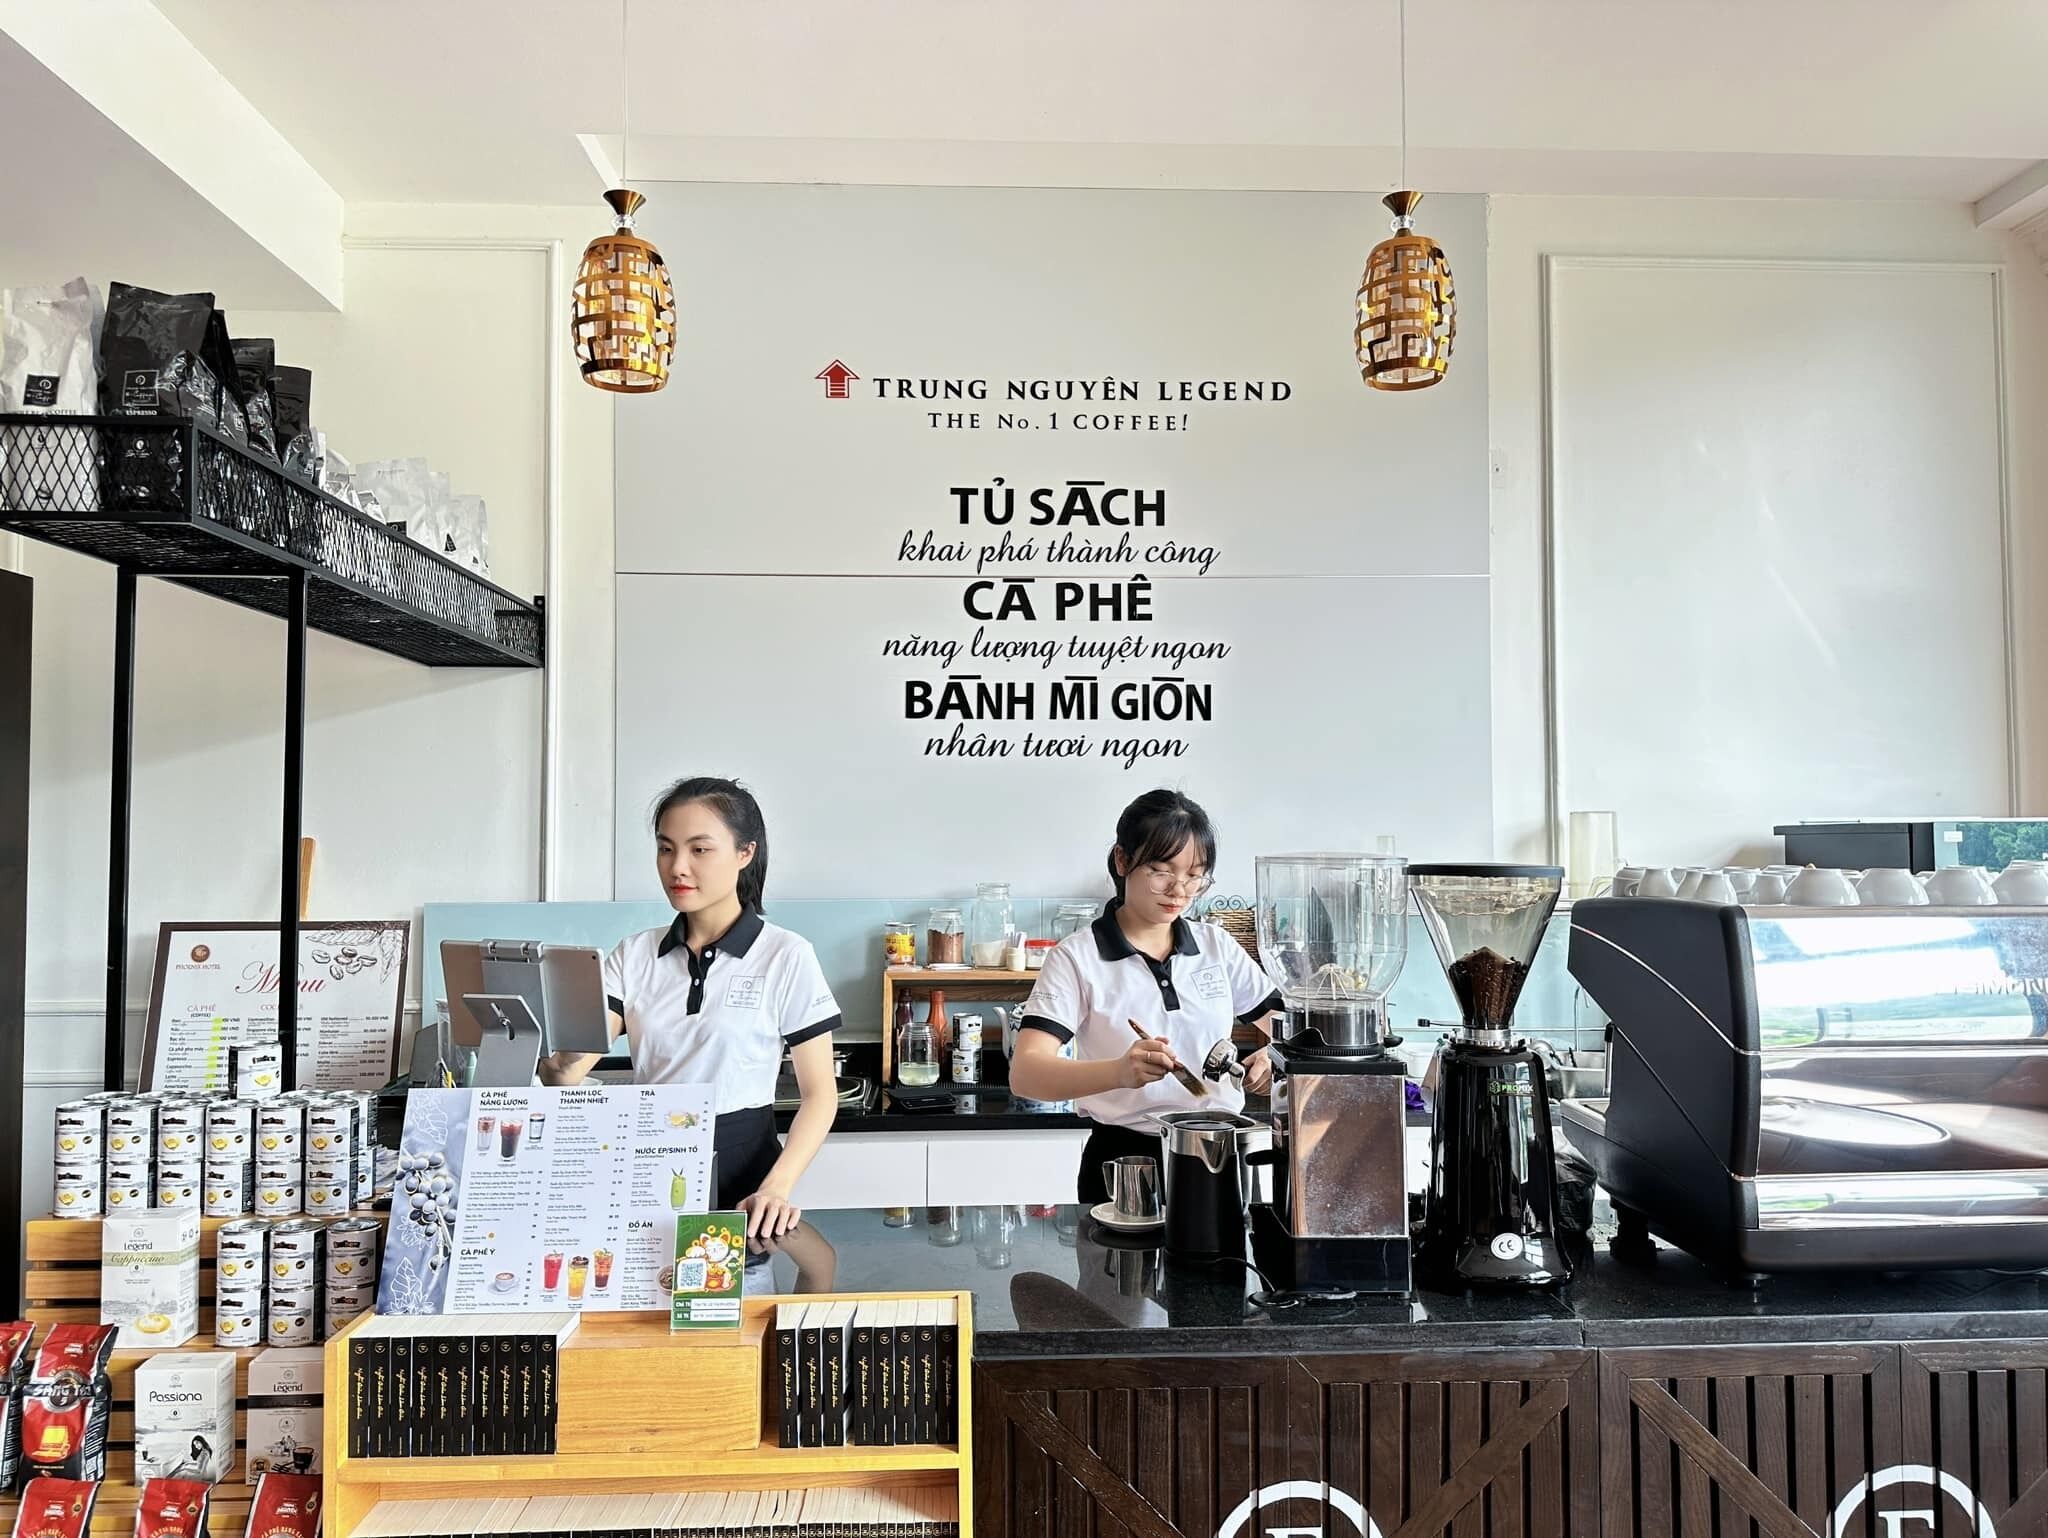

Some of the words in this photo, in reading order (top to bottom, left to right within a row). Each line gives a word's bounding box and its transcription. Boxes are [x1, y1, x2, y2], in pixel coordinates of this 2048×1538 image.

[872, 378, 987, 400] TRUNG
[1007, 375, 1139, 401] NGUYÊN
[1158, 381, 1292, 402] LEGEND
[927, 412, 981, 429] THE
[1073, 414, 1189, 431] COFFEE!
[949, 476, 1015, 526] TỦ
[898, 529, 972, 562] khai
[977, 530, 1041, 575] phá
[1046, 531, 1140, 563] thành
[1144, 540, 1222, 576] công
[1055, 573, 1154, 622] PHÊ
[882, 634, 964, 670] năng
[971, 625, 1063, 670] lượng
[1068, 635, 1150, 670] tuyệt
[1151, 641, 1232, 671] ngon
[924, 722, 1016, 757] nhân
[1023, 732, 1094, 758] tươi
[1100, 738, 1190, 770] ngon
[149, 1390, 203, 1403] Passiona
[273, 1383, 304, 1393] Legend
